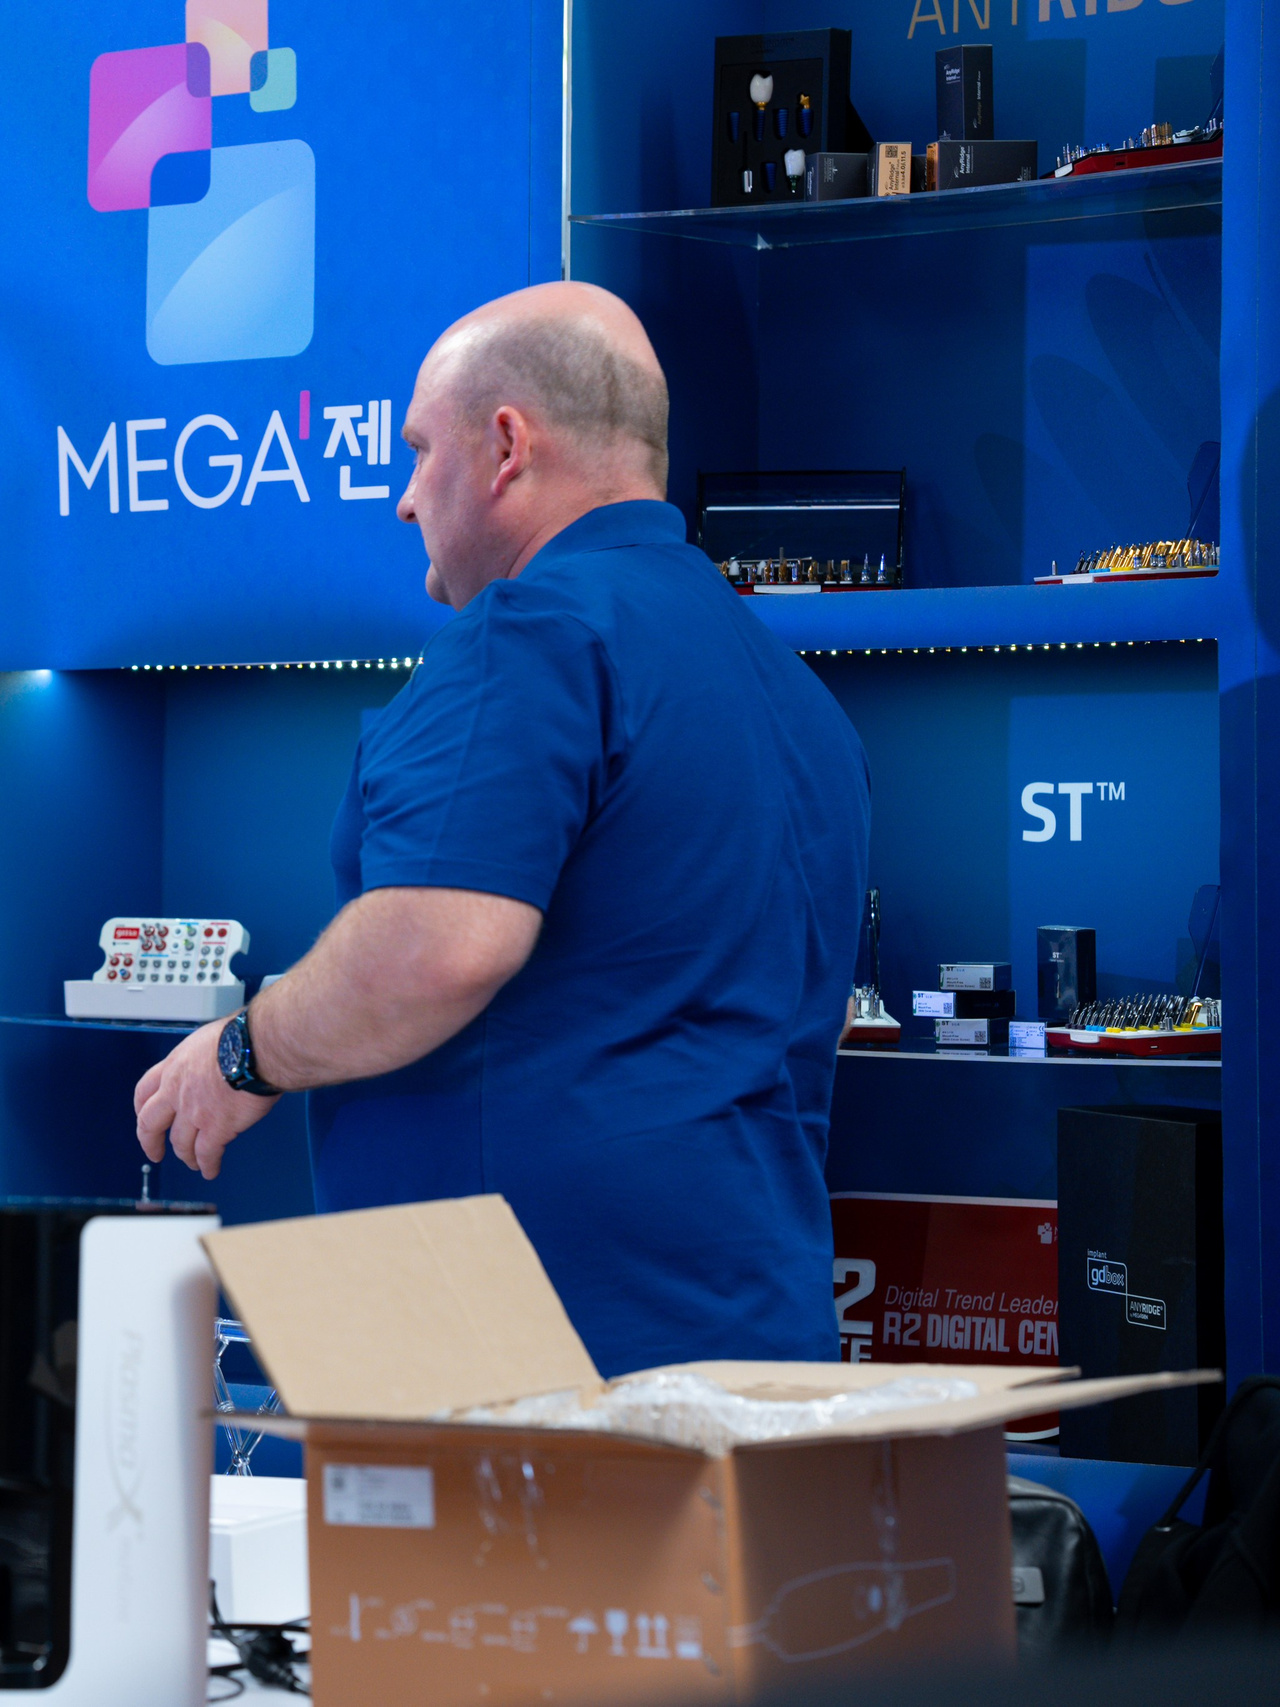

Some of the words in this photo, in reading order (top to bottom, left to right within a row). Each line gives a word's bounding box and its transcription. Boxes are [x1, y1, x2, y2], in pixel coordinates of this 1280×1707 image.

[1087, 1249, 1108, 1260] implant
[1091, 1265, 1125, 1287] gdbox
[884, 1285, 939, 1312] Digital
[944, 1288, 995, 1311] Trend
[882, 1311, 922, 1346] R2
[926, 1313, 1010, 1353] DIGITAL
